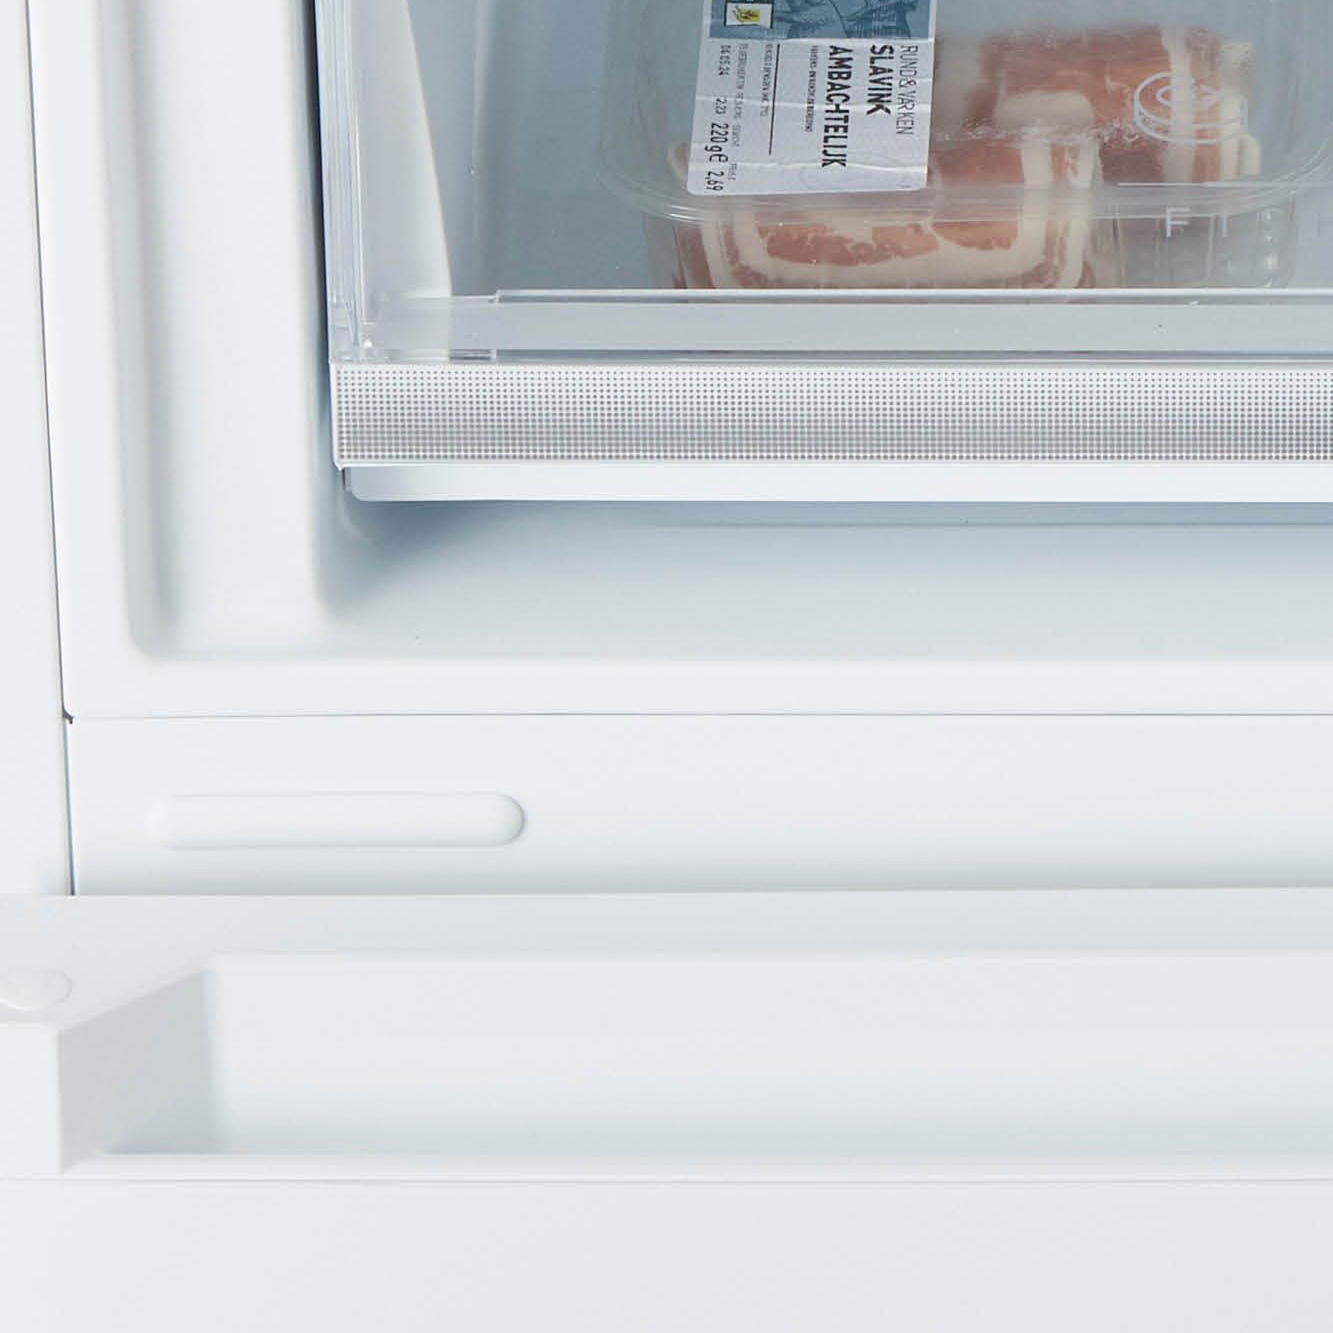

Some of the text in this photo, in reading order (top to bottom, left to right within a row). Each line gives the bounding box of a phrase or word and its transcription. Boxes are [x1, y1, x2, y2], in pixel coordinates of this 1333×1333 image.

[866, 44, 895, 116] SLAVINK
[896, 45, 918, 136] RUND VARKEN
